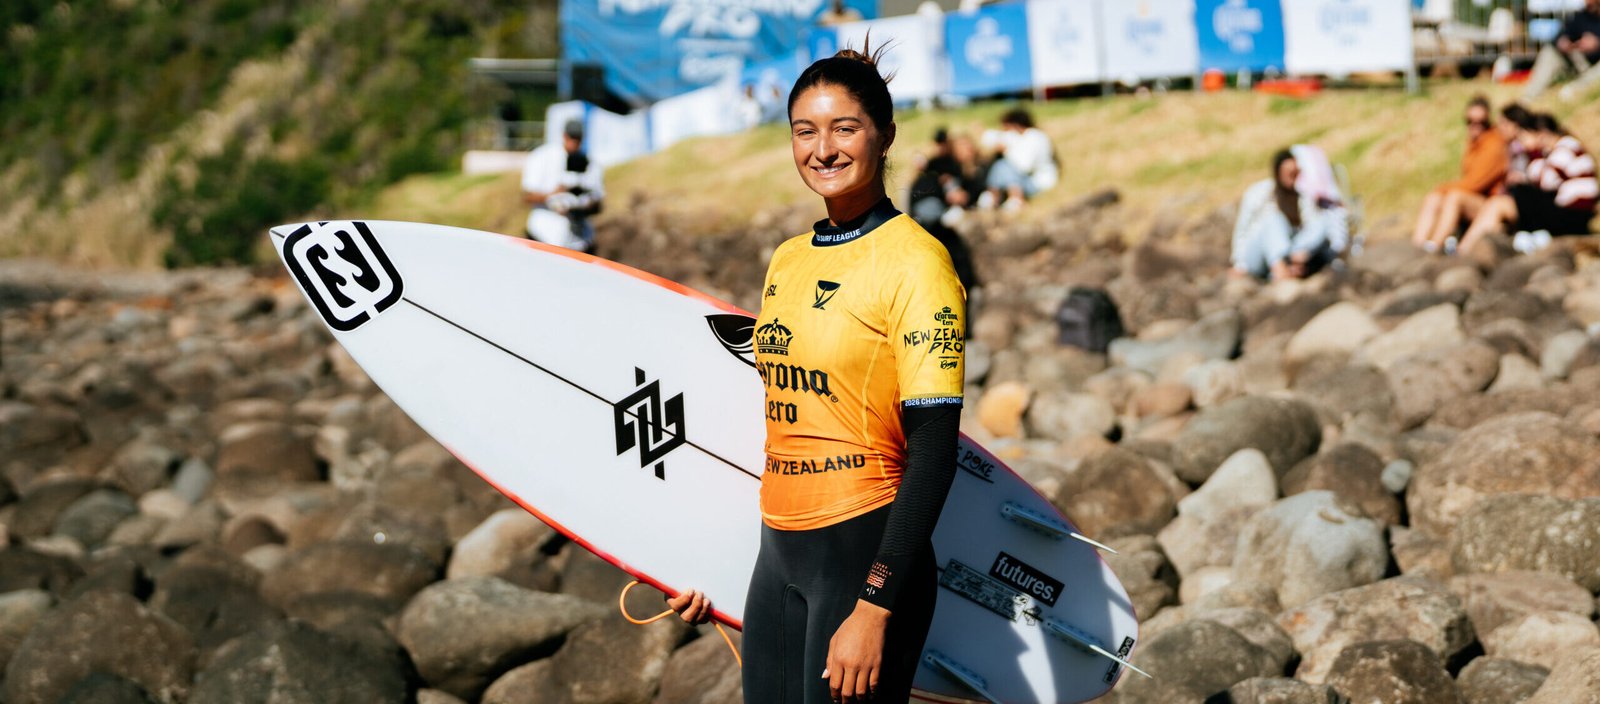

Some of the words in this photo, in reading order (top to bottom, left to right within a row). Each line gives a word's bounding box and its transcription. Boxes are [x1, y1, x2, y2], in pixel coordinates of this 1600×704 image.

[832, 229, 861, 242] LEAGUE
[934, 311, 959, 322] Corona
[903, 330, 930, 350] NEW
[933, 328, 965, 342] ZEAL
[928, 341, 963, 354] PRO
[766, 400, 798, 425] ero
[767, 457, 780, 474] EW
[782, 454, 866, 475] ZEALAND
[995, 556, 1054, 603] futures.
